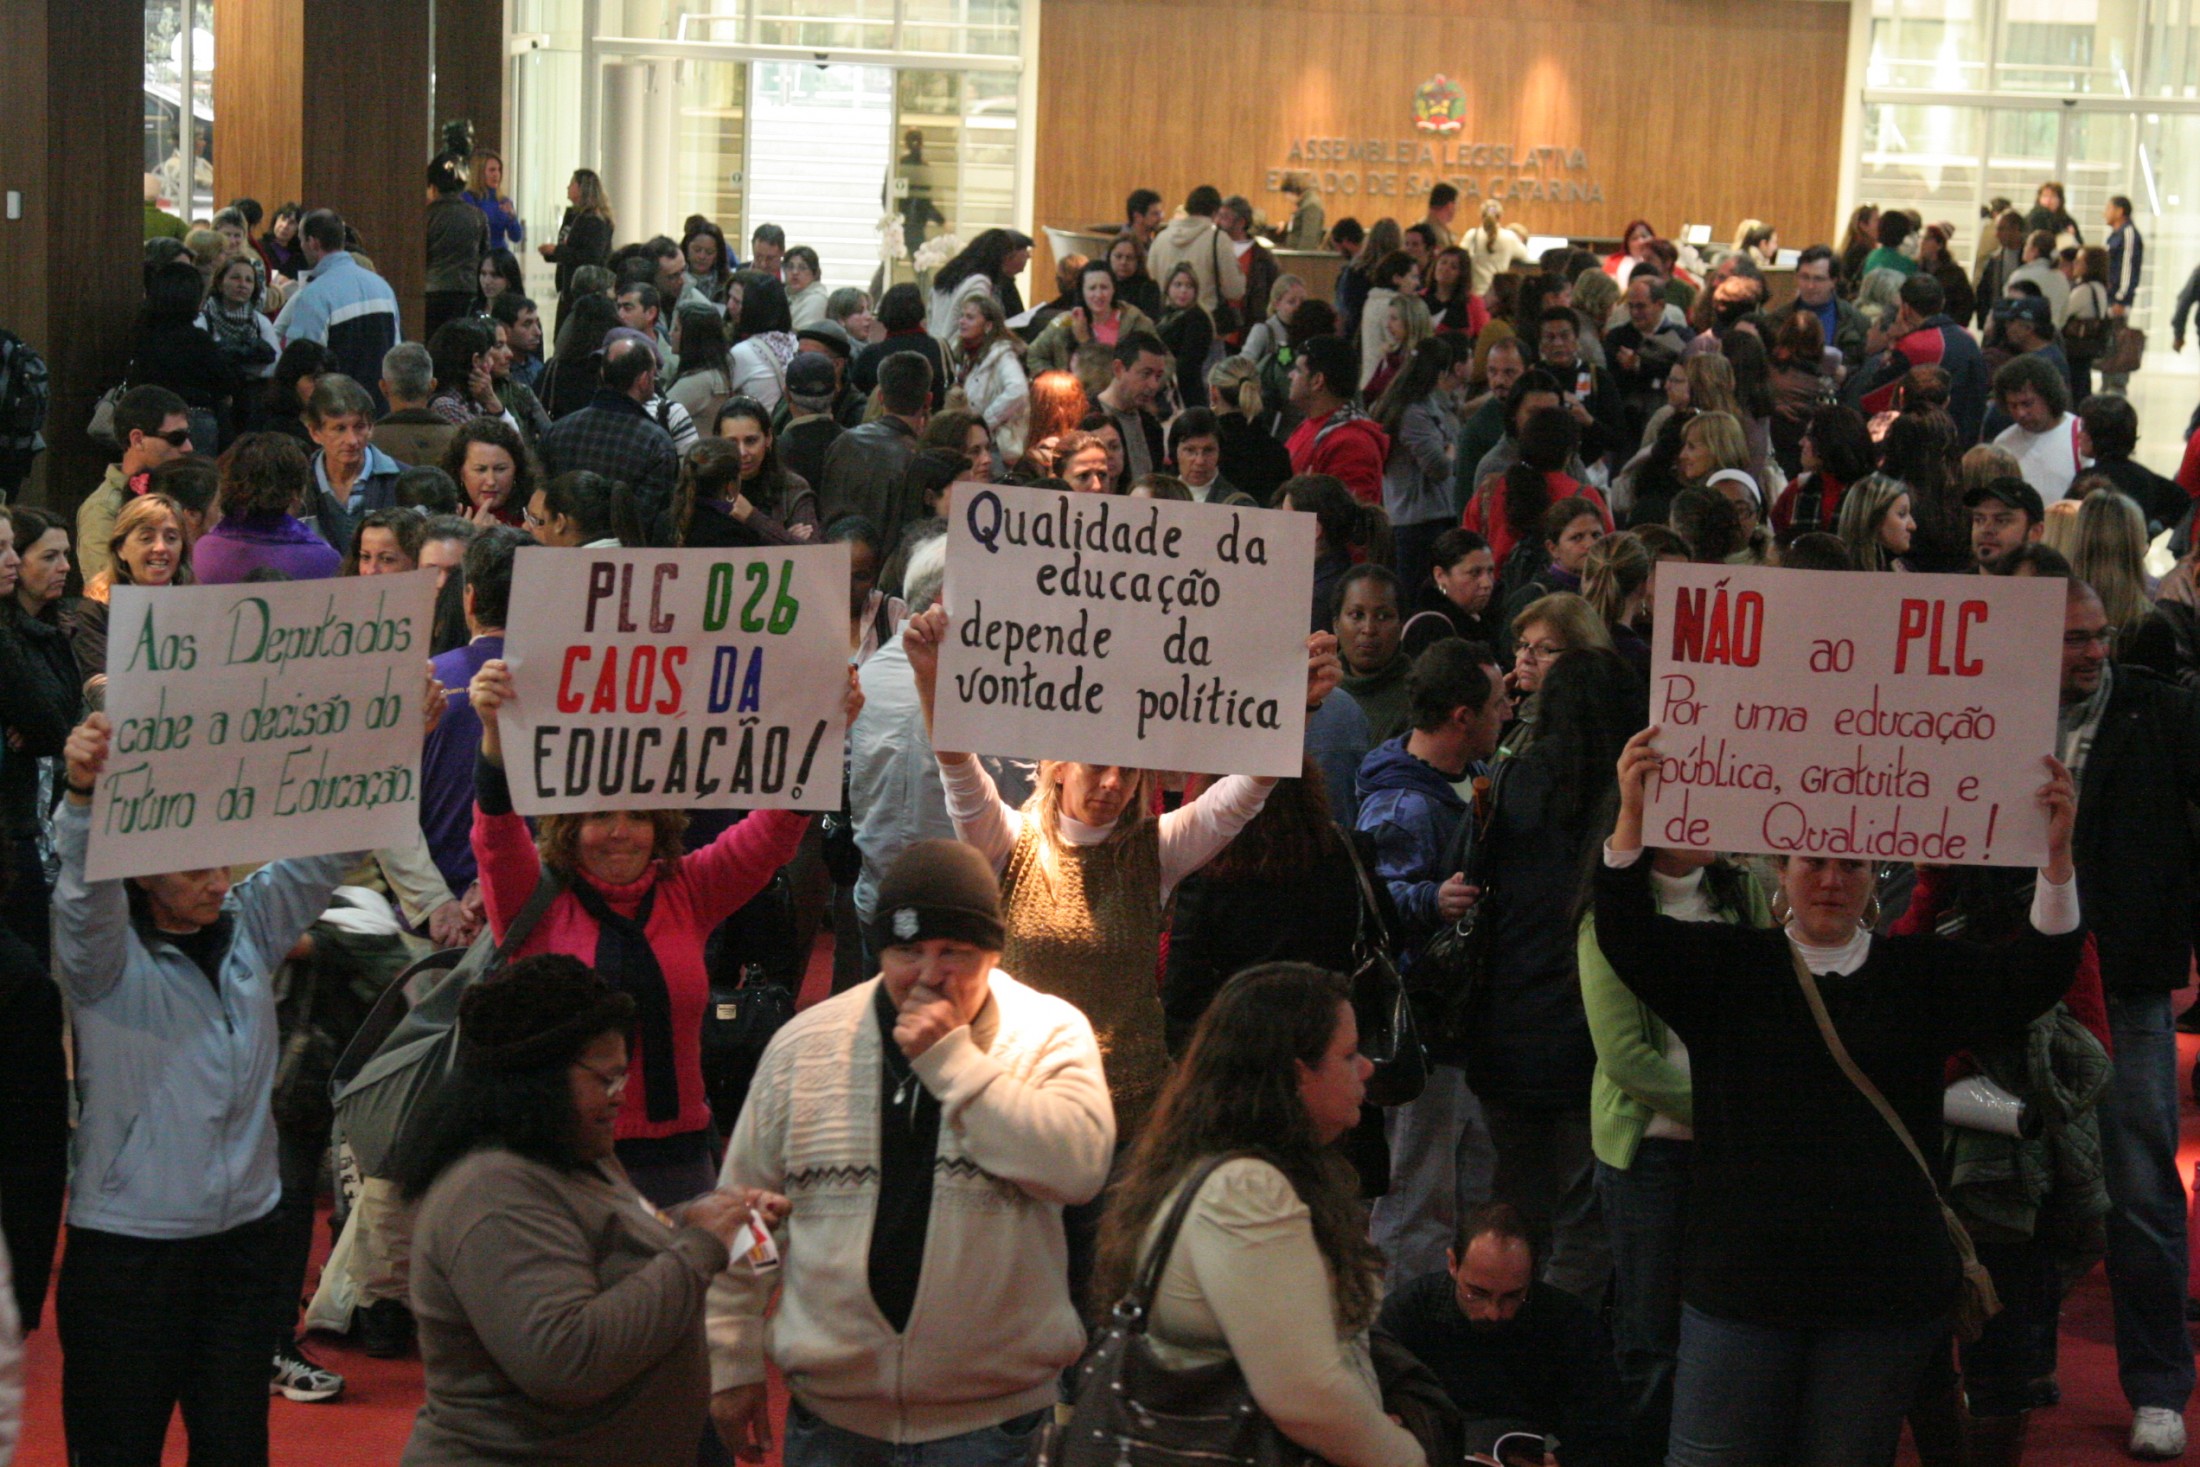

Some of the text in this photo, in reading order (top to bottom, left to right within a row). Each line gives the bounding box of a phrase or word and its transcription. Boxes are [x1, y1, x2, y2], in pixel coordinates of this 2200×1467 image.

[1288, 137, 1588, 171] ASSEMBLEIA LEGISLATIVA
[1367, 171, 1399, 197] DE
[1406, 173, 1480, 198] SATA
[967, 490, 1268, 566] Qualidade da
[584, 559, 800, 635] PLC 026
[1036, 552, 1221, 614] educação
[125, 589, 412, 675] Aos Deputados
[960, 599, 1212, 666] depende da
[1671, 577, 1989, 677] NÃO ao PLC
[117, 666, 402, 754] cabe a decisão do
[556, 645, 763, 716] CAOS DA
[955, 660, 1282, 740] vontade política
[1660, 674, 1996, 745] Por uma educação
[103, 745, 417, 837] Futuro da Educação.
[533, 716, 829, 801] EDUCAÇÃO!
[1655, 737, 1782, 803] pública,
[1956, 773, 1980, 802] e
[1665, 788, 1711, 847] de
